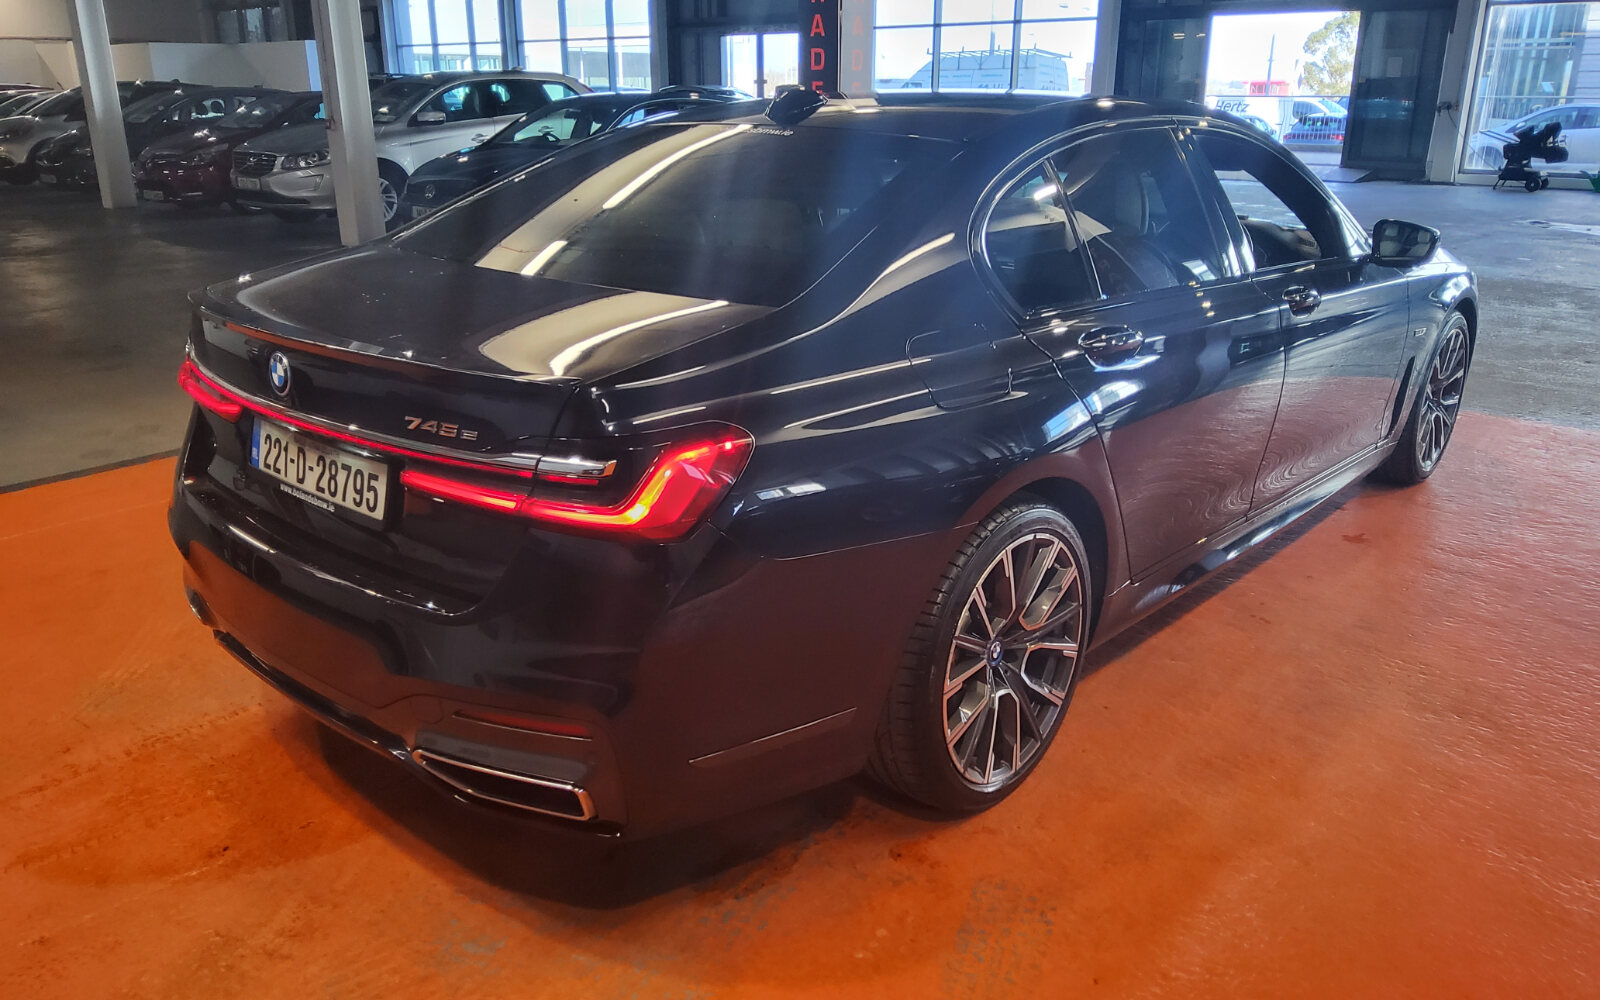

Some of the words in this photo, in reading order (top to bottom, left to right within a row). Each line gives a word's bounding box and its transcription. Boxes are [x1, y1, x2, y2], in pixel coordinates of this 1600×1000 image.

[810, 0, 825, 96] ADE
[1215, 100, 1250, 113] Hertz
[263, 433, 380, 513] 221-D-28795
